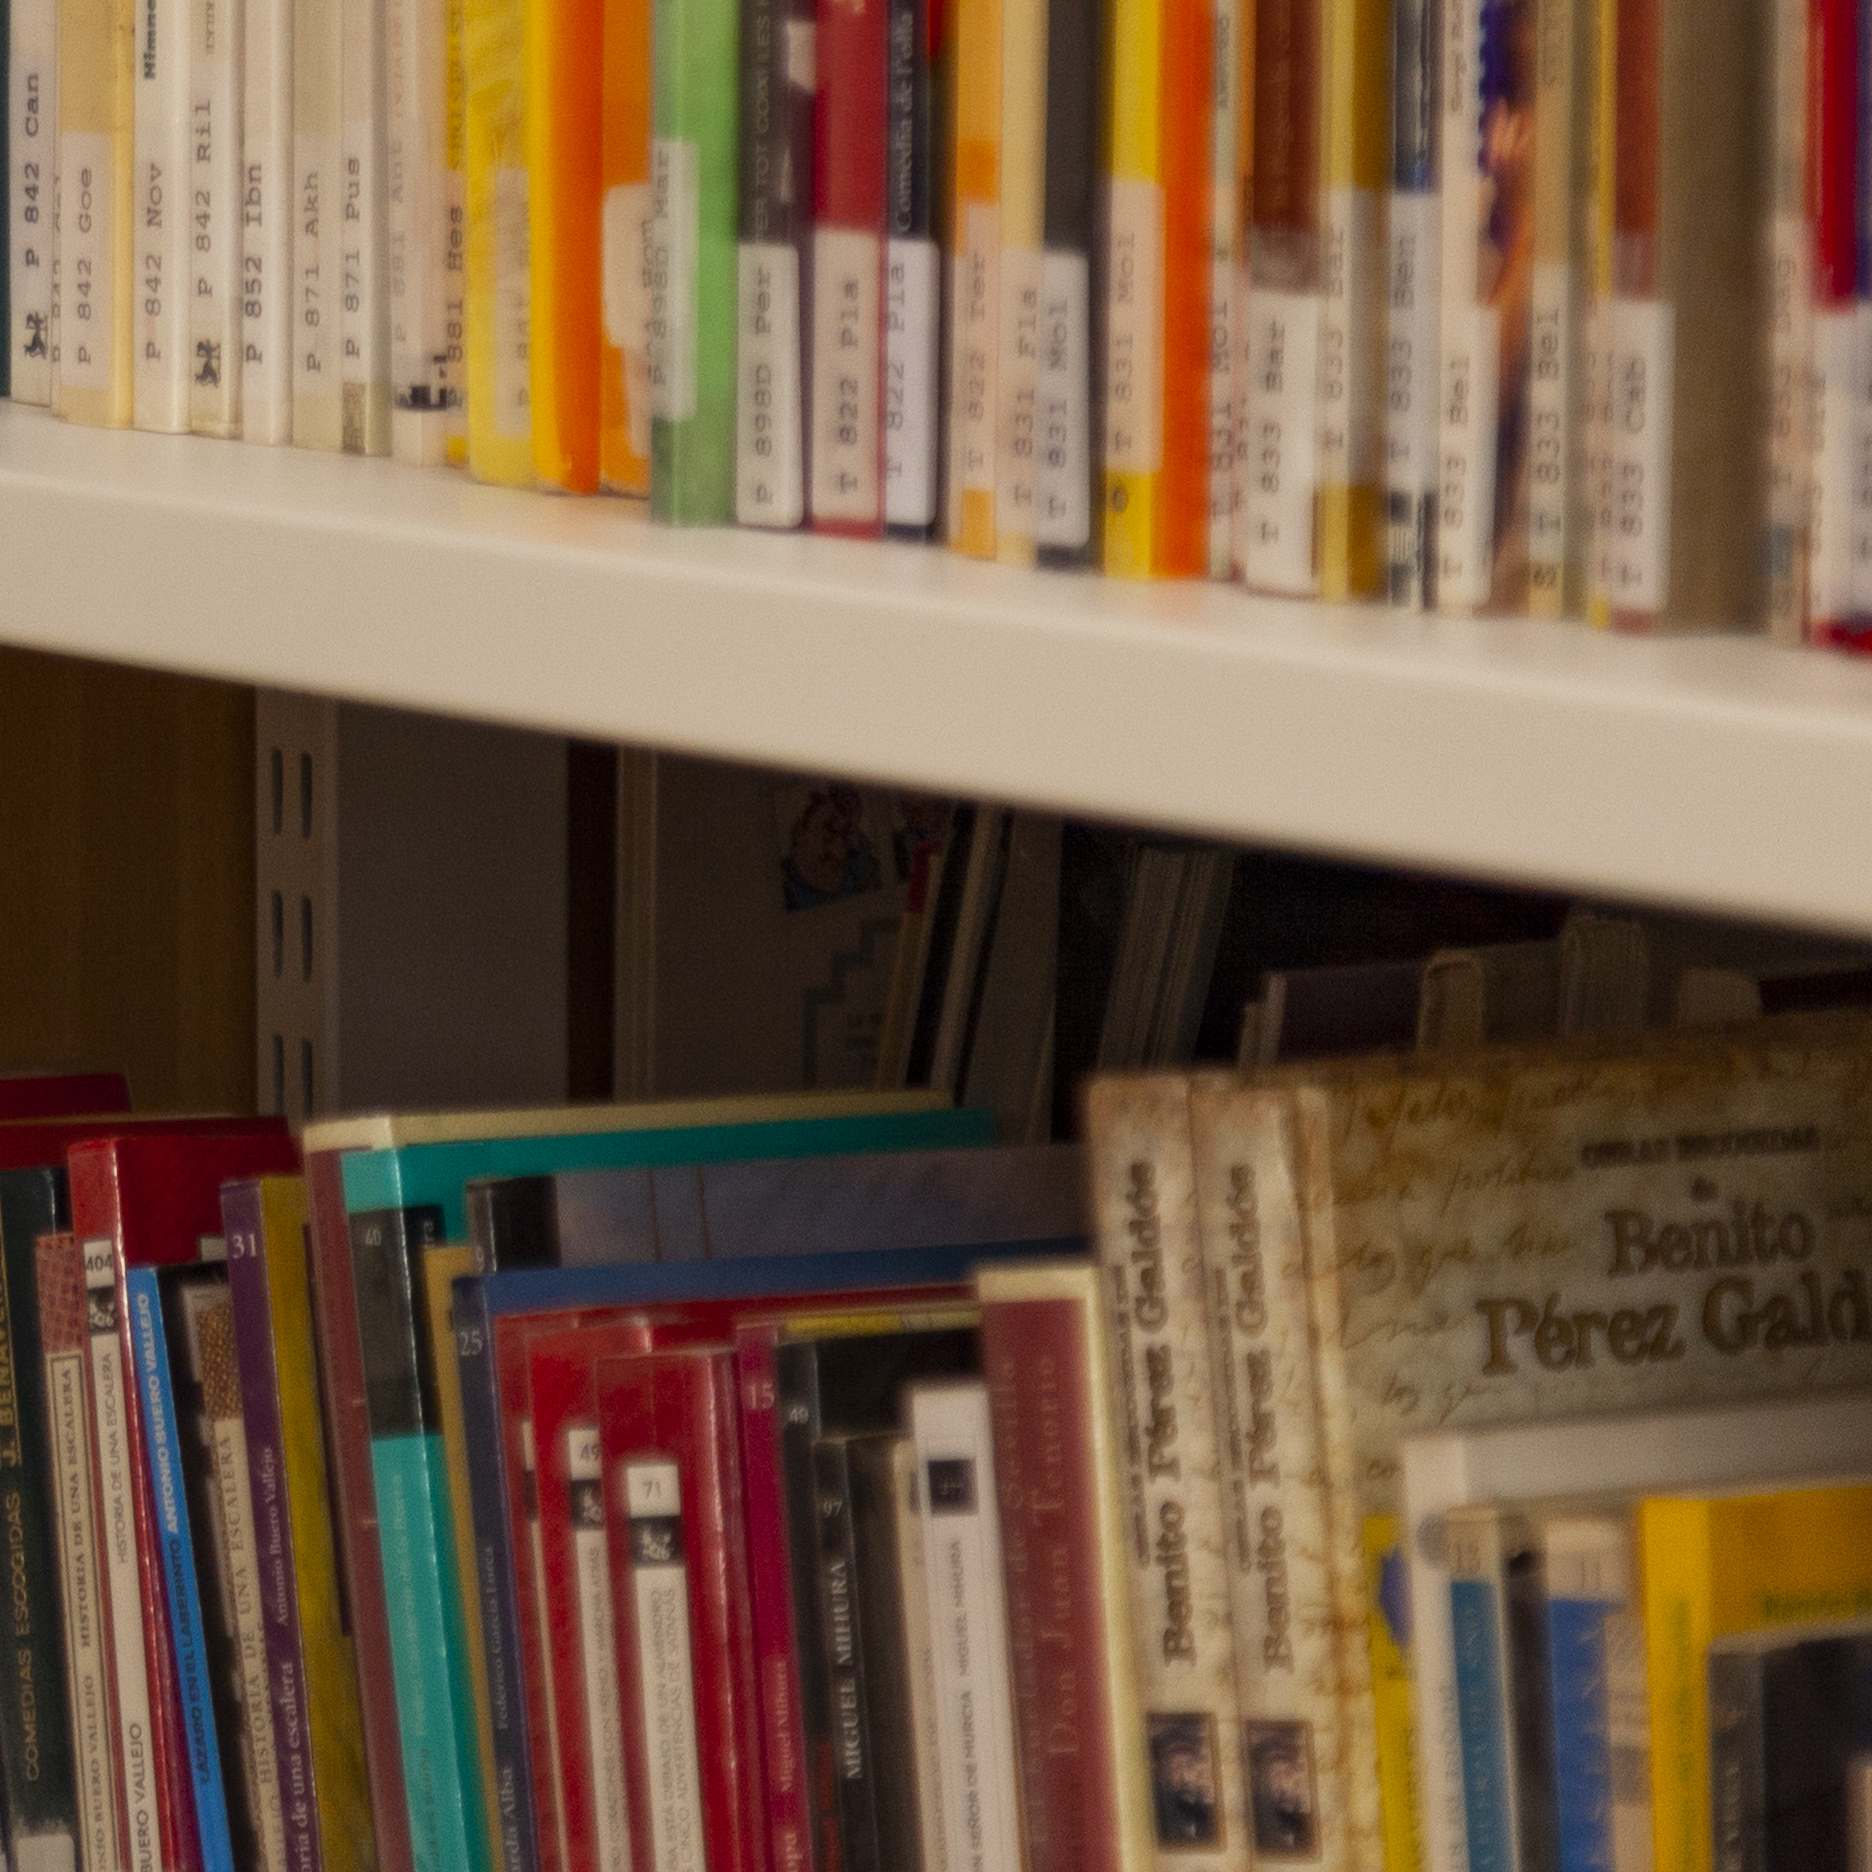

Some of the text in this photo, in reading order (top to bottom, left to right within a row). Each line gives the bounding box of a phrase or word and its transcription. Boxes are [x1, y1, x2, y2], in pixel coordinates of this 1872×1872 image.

[23, 73, 40, 268] P 842 Can
[1125, 1161, 1168, 1334] Galdós
[1605, 1201, 1815, 1279] Benito
[1155, 1502, 1196, 1666] Benito
